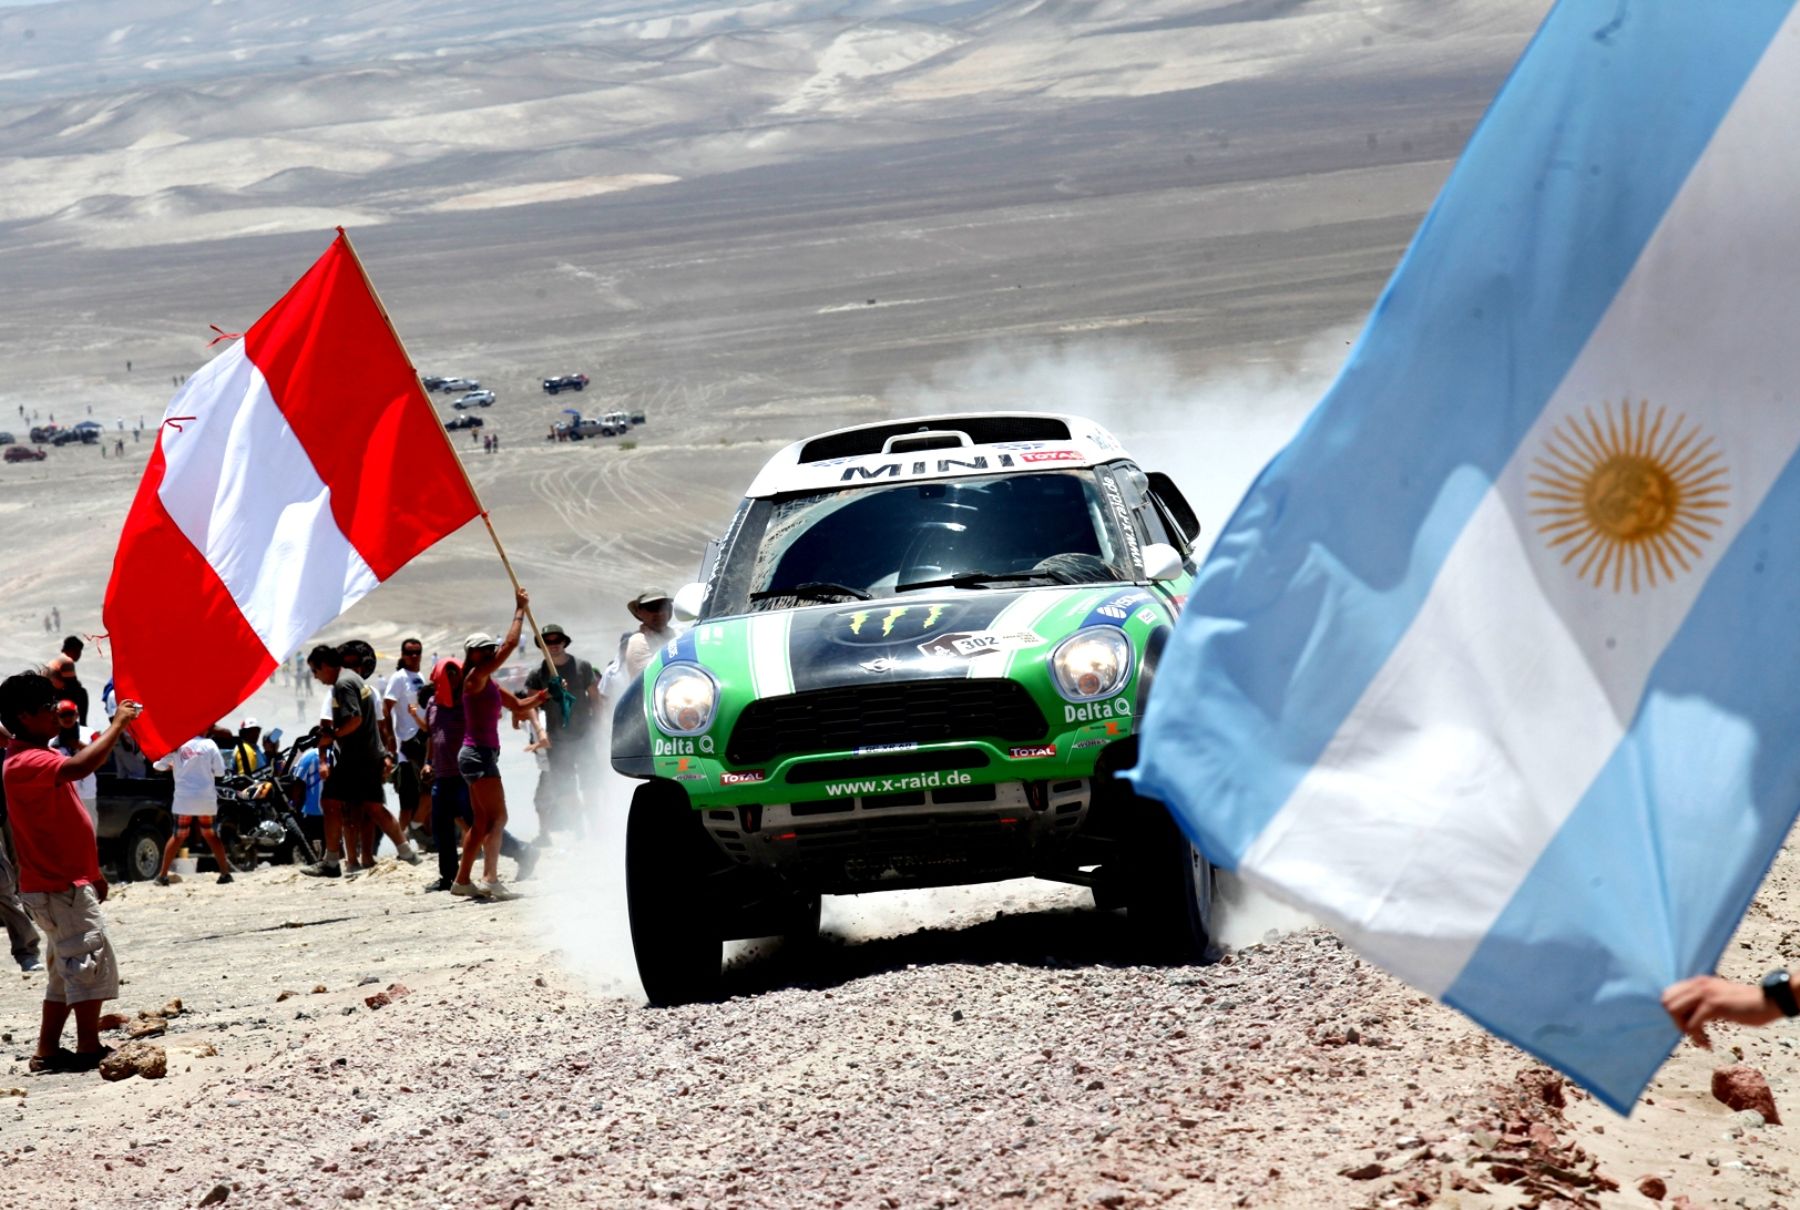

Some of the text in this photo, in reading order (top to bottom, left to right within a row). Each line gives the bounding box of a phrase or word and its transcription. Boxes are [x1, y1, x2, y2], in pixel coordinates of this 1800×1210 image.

[840, 454, 1015, 481] MINI
[961, 636, 999, 650] 302
[1064, 702, 1112, 723] Delta
[655, 738, 695, 756] Delta
[1010, 747, 1056, 758] TOTAL
[721, 772, 763, 784] TOTAL
[825, 770, 972, 796] www.x-raid.de
